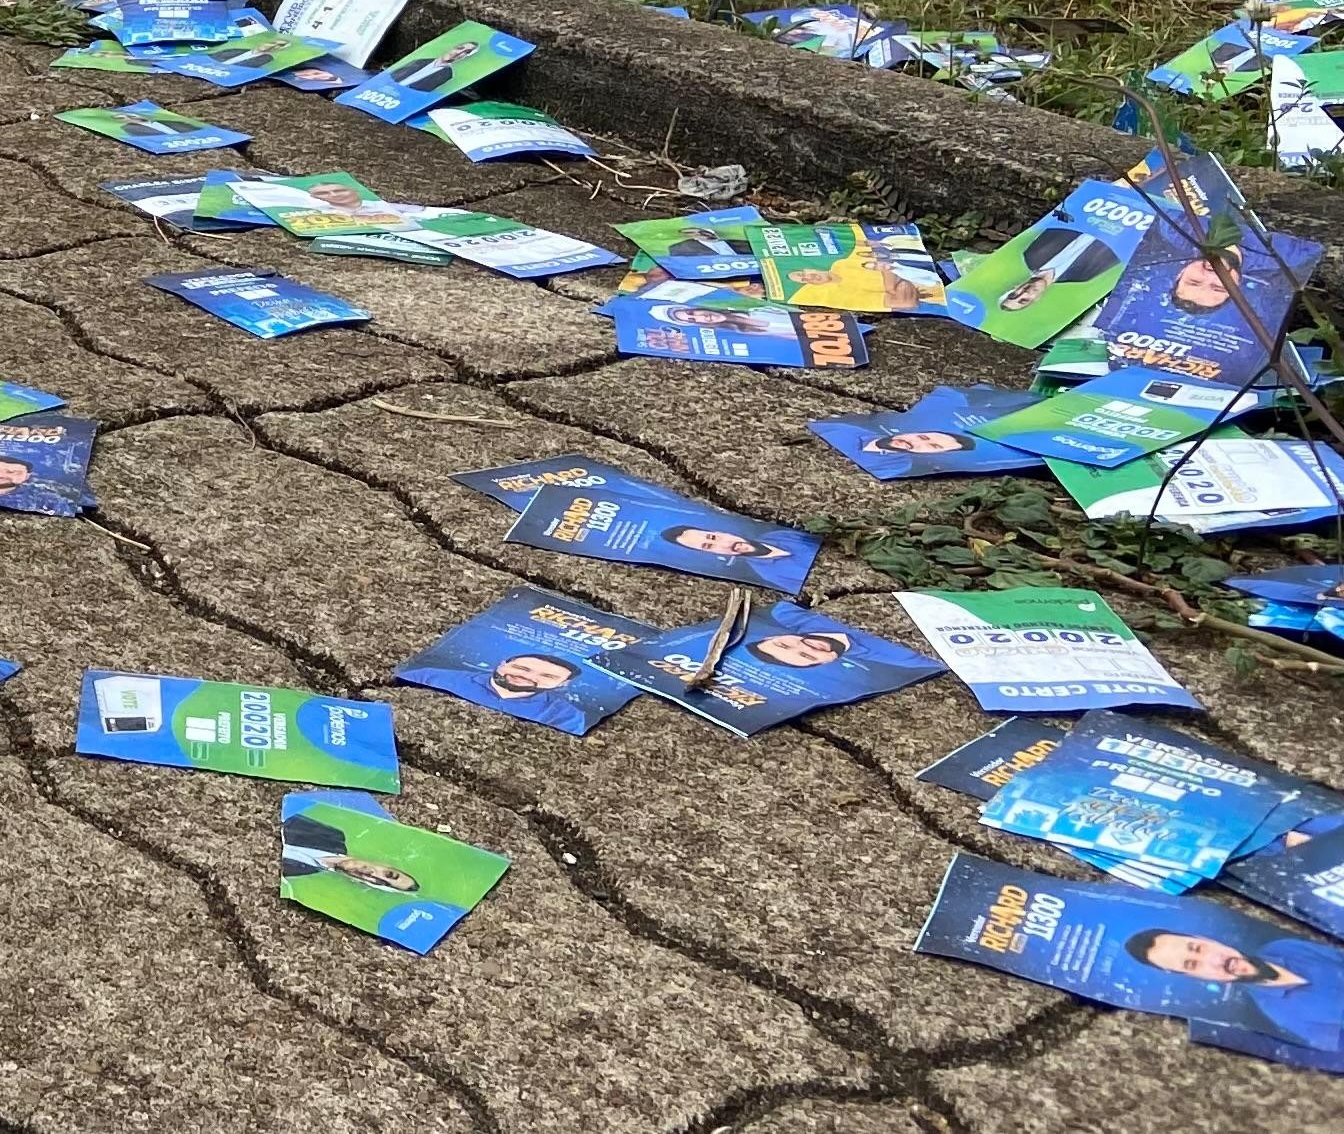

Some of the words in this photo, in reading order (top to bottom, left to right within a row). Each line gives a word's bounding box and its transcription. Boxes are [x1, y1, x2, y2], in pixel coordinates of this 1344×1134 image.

[1117, 330, 1192, 356] 11300
[498, 467, 589, 492] RICHARD
[551, 497, 594, 543] RICHARD
[587, 502, 622, 532] 11300
[949, 631, 1123, 646] 20020
[120, 689, 139, 710] VOTE
[999, 684, 1088, 698] CERTO
[1090, 683, 1168, 697] VOTE
[216, 712, 231, 745] PREFEITO
[241, 691, 271, 750] 20020
[272, 712, 288, 751] VEREADOR
[322, 703, 368, 747] podemos
[980, 738, 1059, 788] RICHARD
[1090, 760, 1223, 798] PREFEITO
[979, 884, 1029, 953] RICHARD
[1022, 892, 1066, 942] 11300
